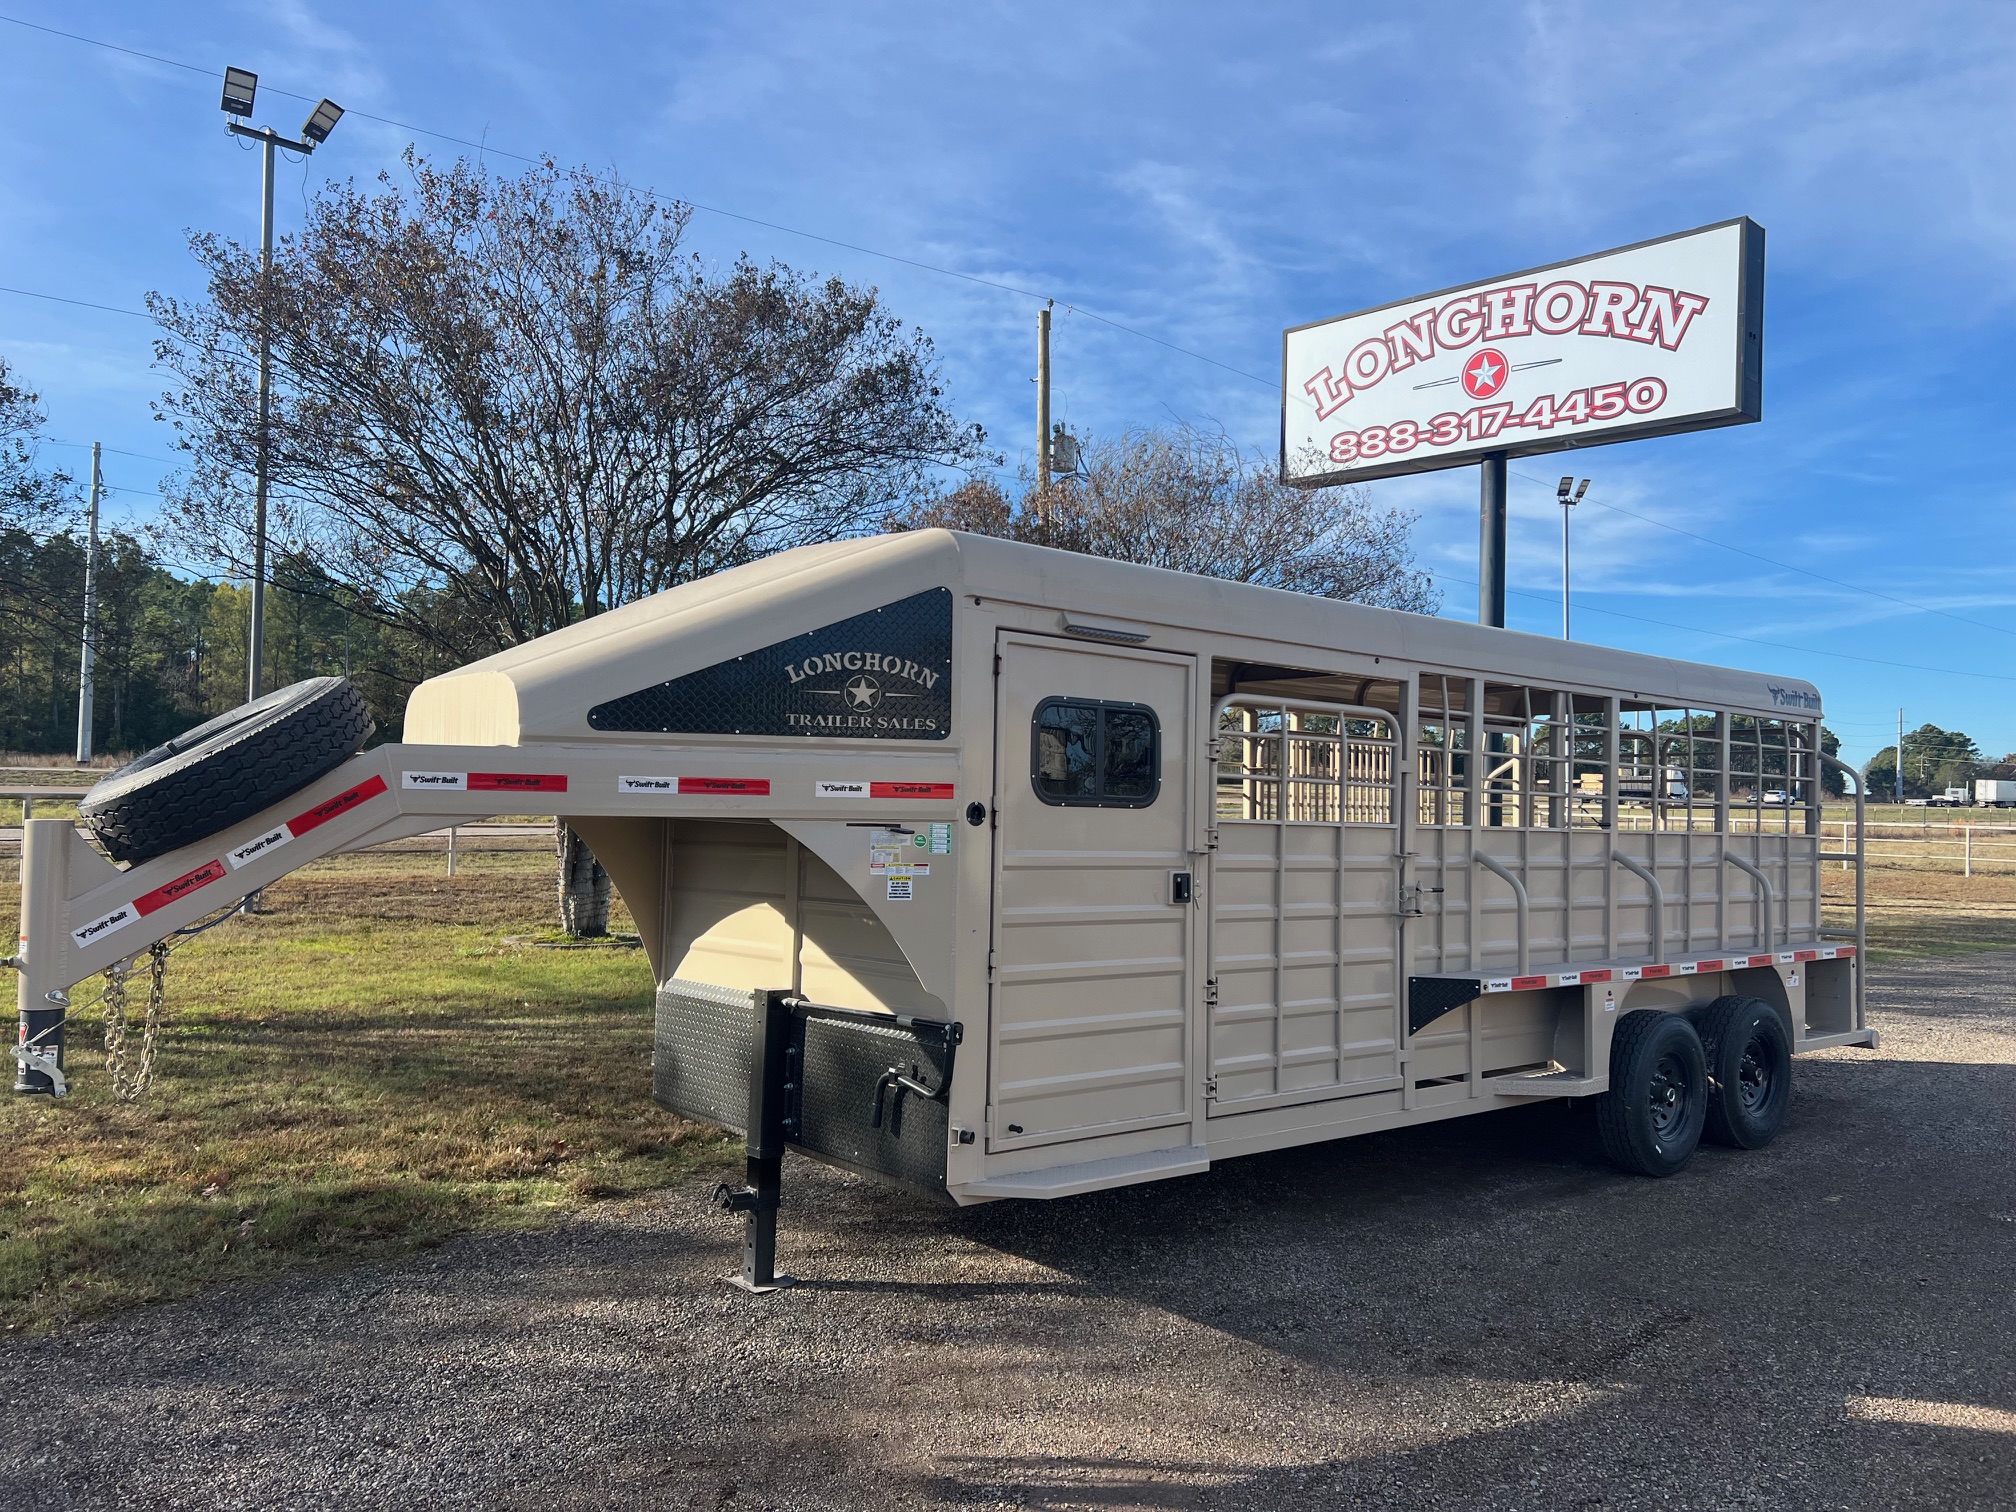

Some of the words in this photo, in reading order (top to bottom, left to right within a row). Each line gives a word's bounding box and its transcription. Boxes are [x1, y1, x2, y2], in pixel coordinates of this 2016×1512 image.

[1304, 280, 1709, 421] LONGHORN
[1330, 377, 1668, 463] 888-317-4450
[785, 652, 940, 690] LONGHORN
[786, 713, 873, 728] TRAILER
[877, 717, 936, 731] SALES
[244, 841, 266, 856] Swift
[265, 832, 282, 845] Built
[87, 920, 110, 936] Swift
[109, 910, 128, 924] Built
